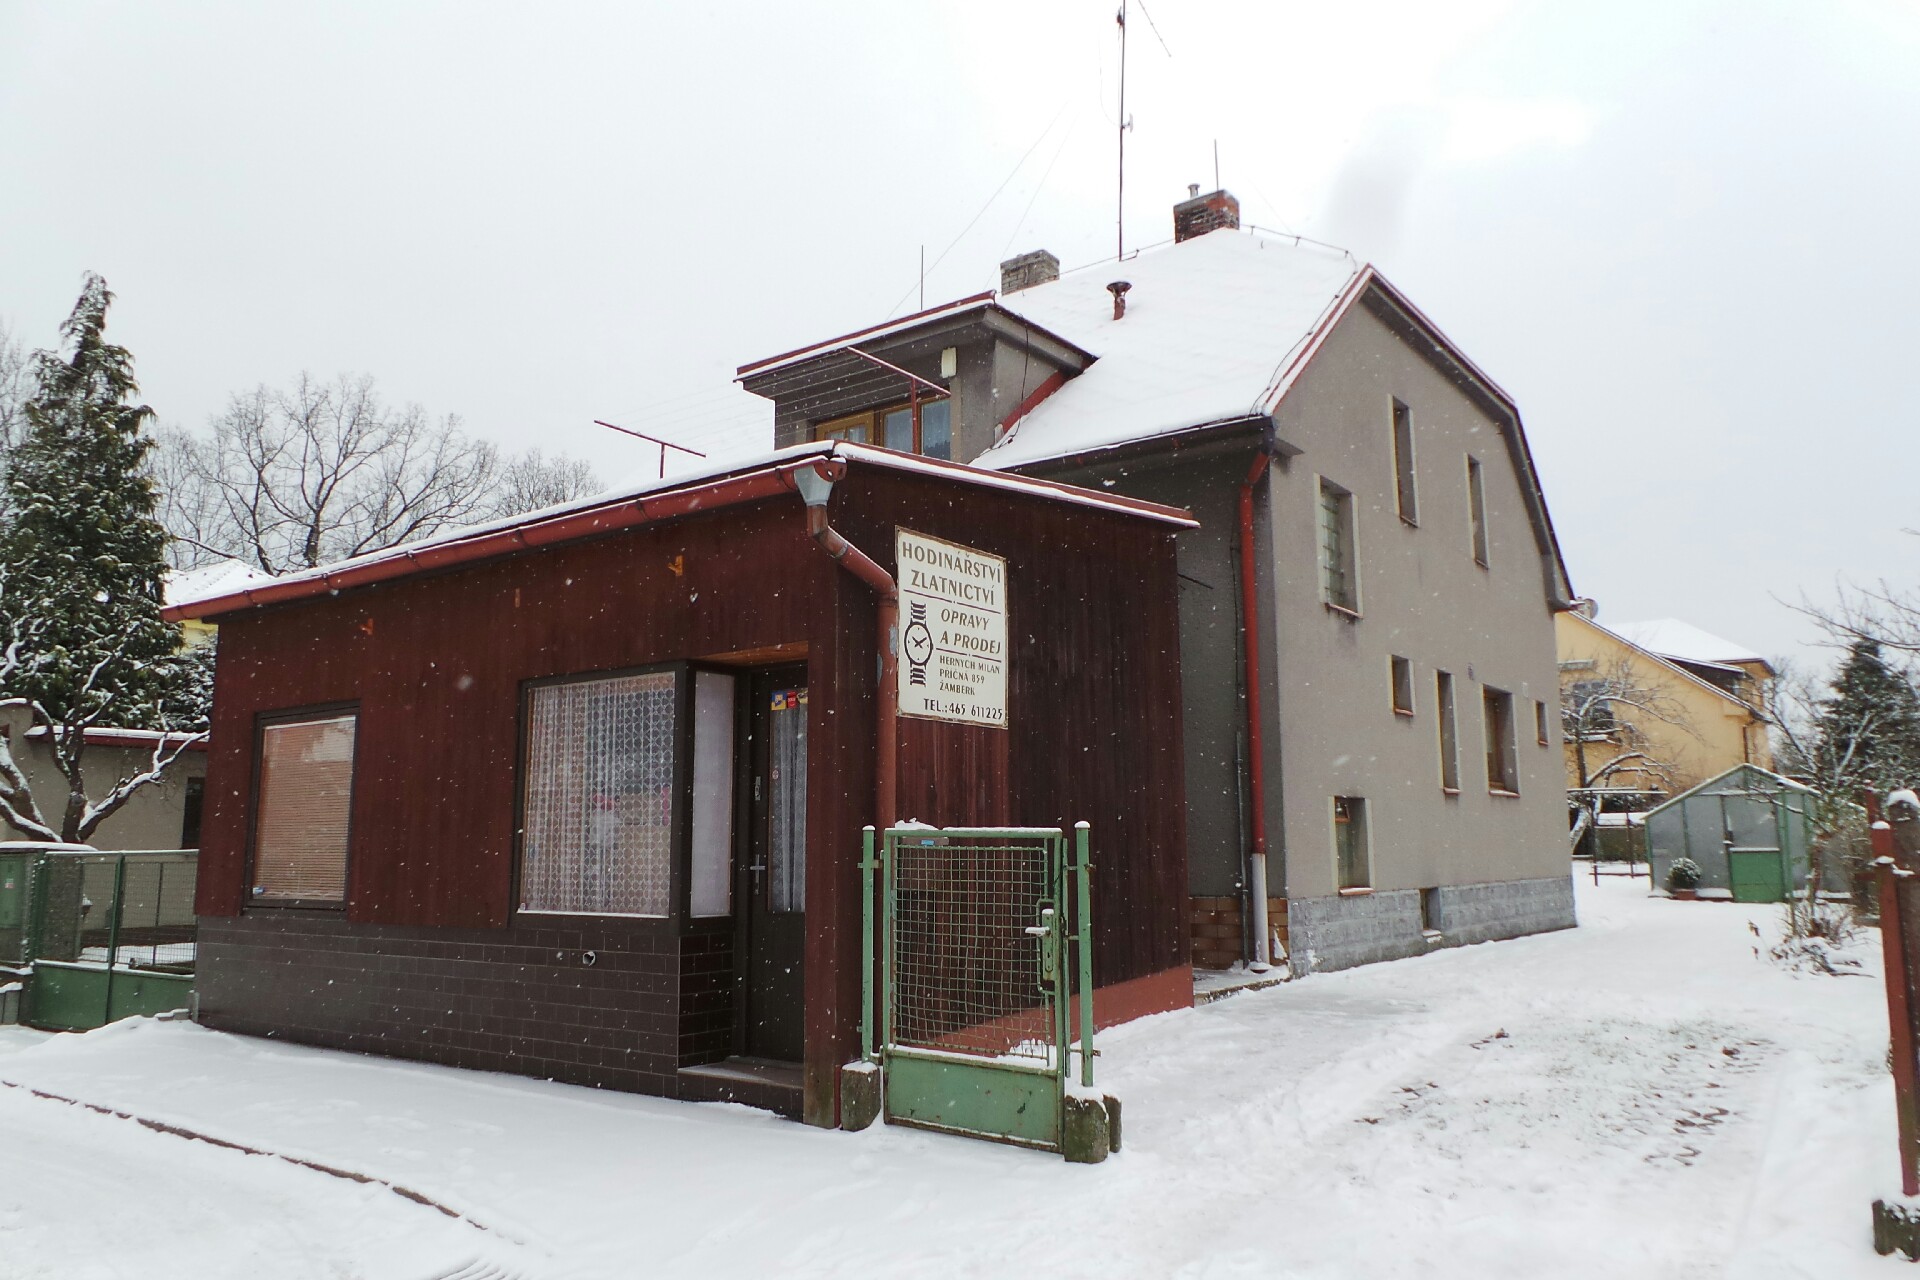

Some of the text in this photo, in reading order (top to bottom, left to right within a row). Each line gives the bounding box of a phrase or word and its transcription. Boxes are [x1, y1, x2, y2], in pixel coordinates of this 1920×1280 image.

[902, 541, 1001, 583] HODINÁŘSTVÍ
[911, 569, 994, 606] ZLATNICTVÍ
[941, 608, 989, 630] OPRAVY
[940, 630, 1001, 655] A PRODEJ
[940, 655, 1000, 674] HERNYCH MILAN
[971, 673, 985, 684] 859
[971, 704, 1003, 720] 611225
